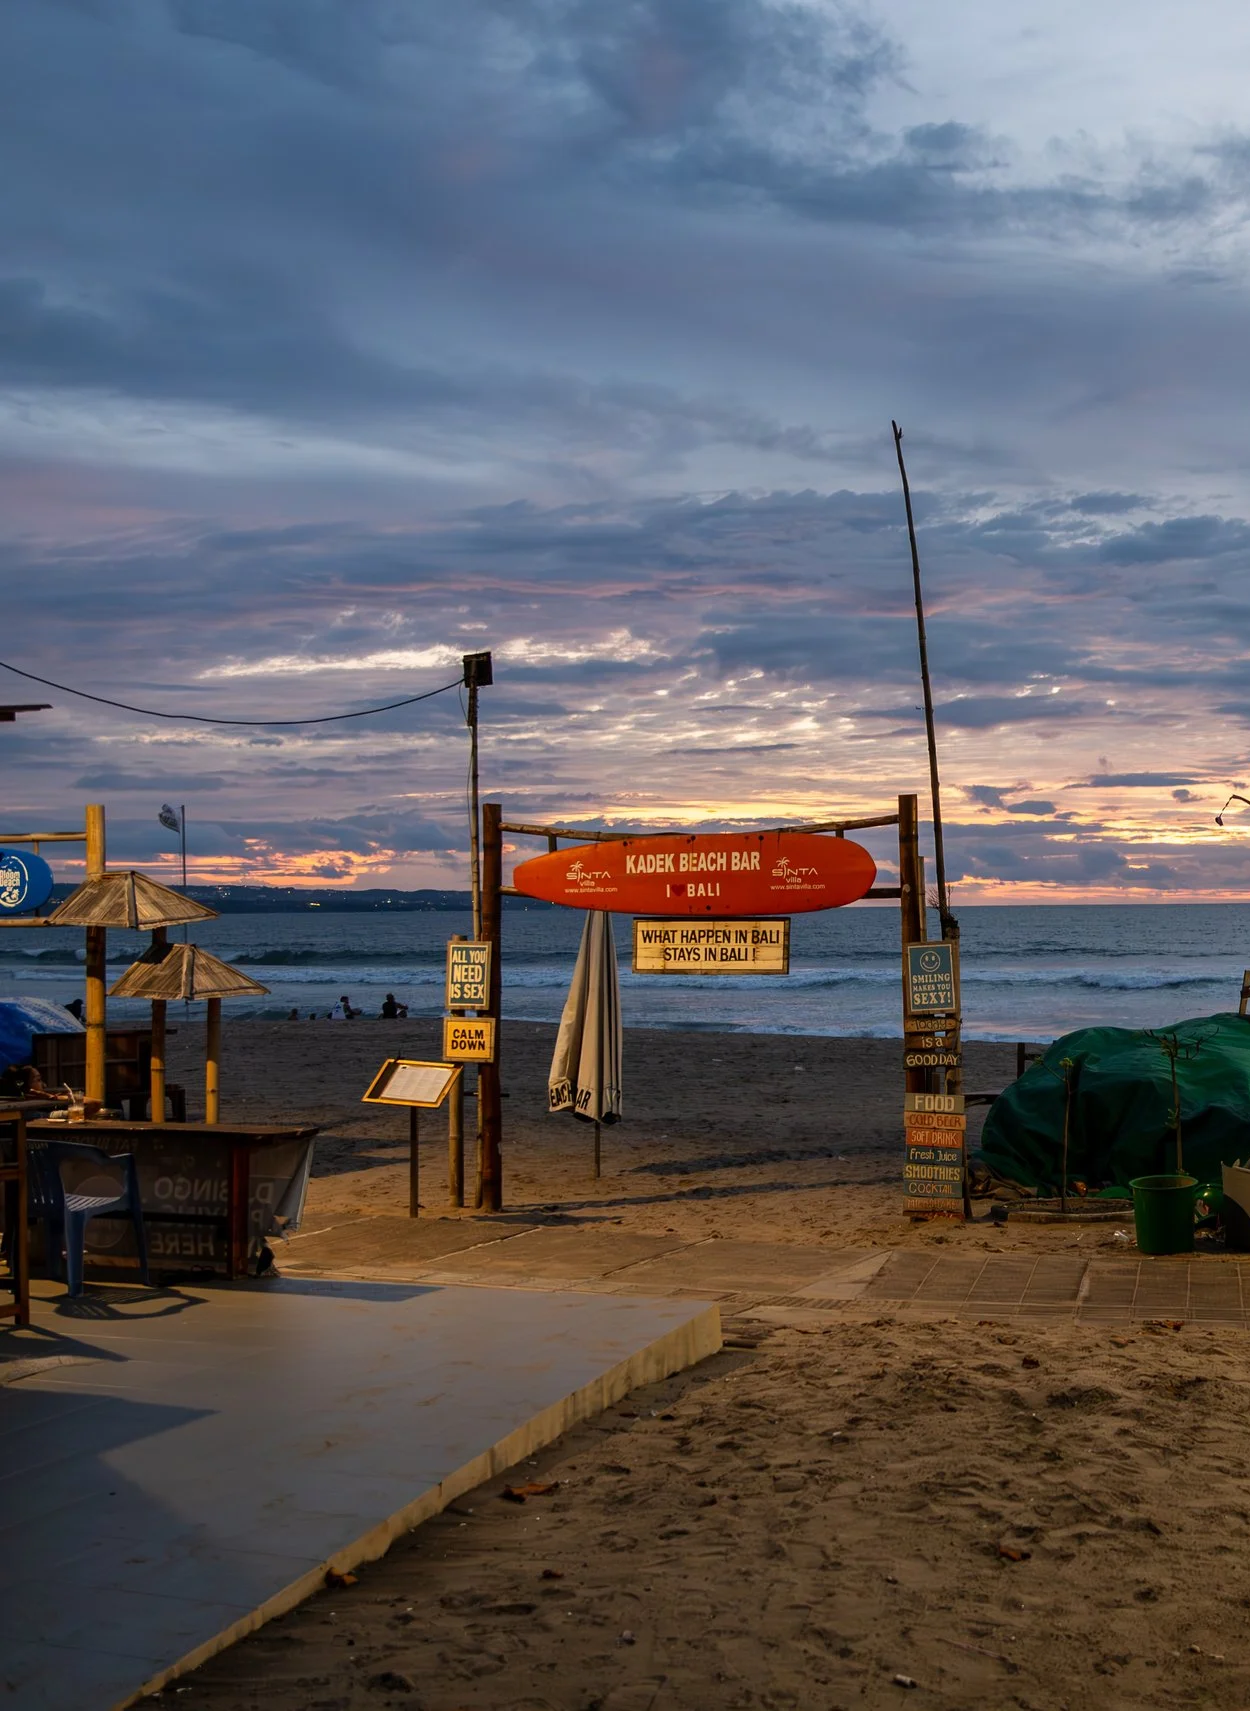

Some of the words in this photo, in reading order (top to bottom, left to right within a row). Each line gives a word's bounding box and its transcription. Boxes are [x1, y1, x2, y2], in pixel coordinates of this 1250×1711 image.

[626, 853, 675, 874] KADEK
[679, 851, 727, 872] BEACH
[731, 851, 761, 871] BAR
[666, 884, 670, 898] I
[687, 882, 721, 897] BALI
[641, 930, 678, 944] WHAT
[680, 930, 731, 944] HAPPEN
[735, 930, 748, 944] IN
[751, 930, 780, 944] BALI
[452, 950, 467, 963] ALL
[469, 950, 486, 964] YOU
[663, 947, 701, 961] STAYS
[704, 947, 717, 961] IN
[720, 947, 748, 961] BALI
[453, 964, 482, 982] NEED
[912, 973, 951, 984] SMILING
[451, 983, 461, 998] IS
[464, 983, 484, 998] SEX
[913, 984, 936, 992] MAKES
[913, 991, 951, 1005] SEXY!
[453, 1029, 484, 1040] CALM
[922, 1035, 933, 1048] is
[935, 1037, 944, 1047] a
[451, 1040, 485, 1050] DOWN
[906, 1054, 938, 1067] GOOD
[939, 1053, 959, 1065] DAY
[914, 1095, 955, 1112] FOOD
[909, 1113, 934, 1127] COLD
[936, 1114, 961, 1128] BEER
[911, 1130, 930, 1143] SOFT
[932, 1132, 957, 1145] DRINK
[909, 1148, 934, 1160] Fresh
[936, 1150, 957, 1162] Juice
[905, 1165, 960, 1181] SMOOTHIES
[908, 1182, 952, 1194] COCKTAIL
